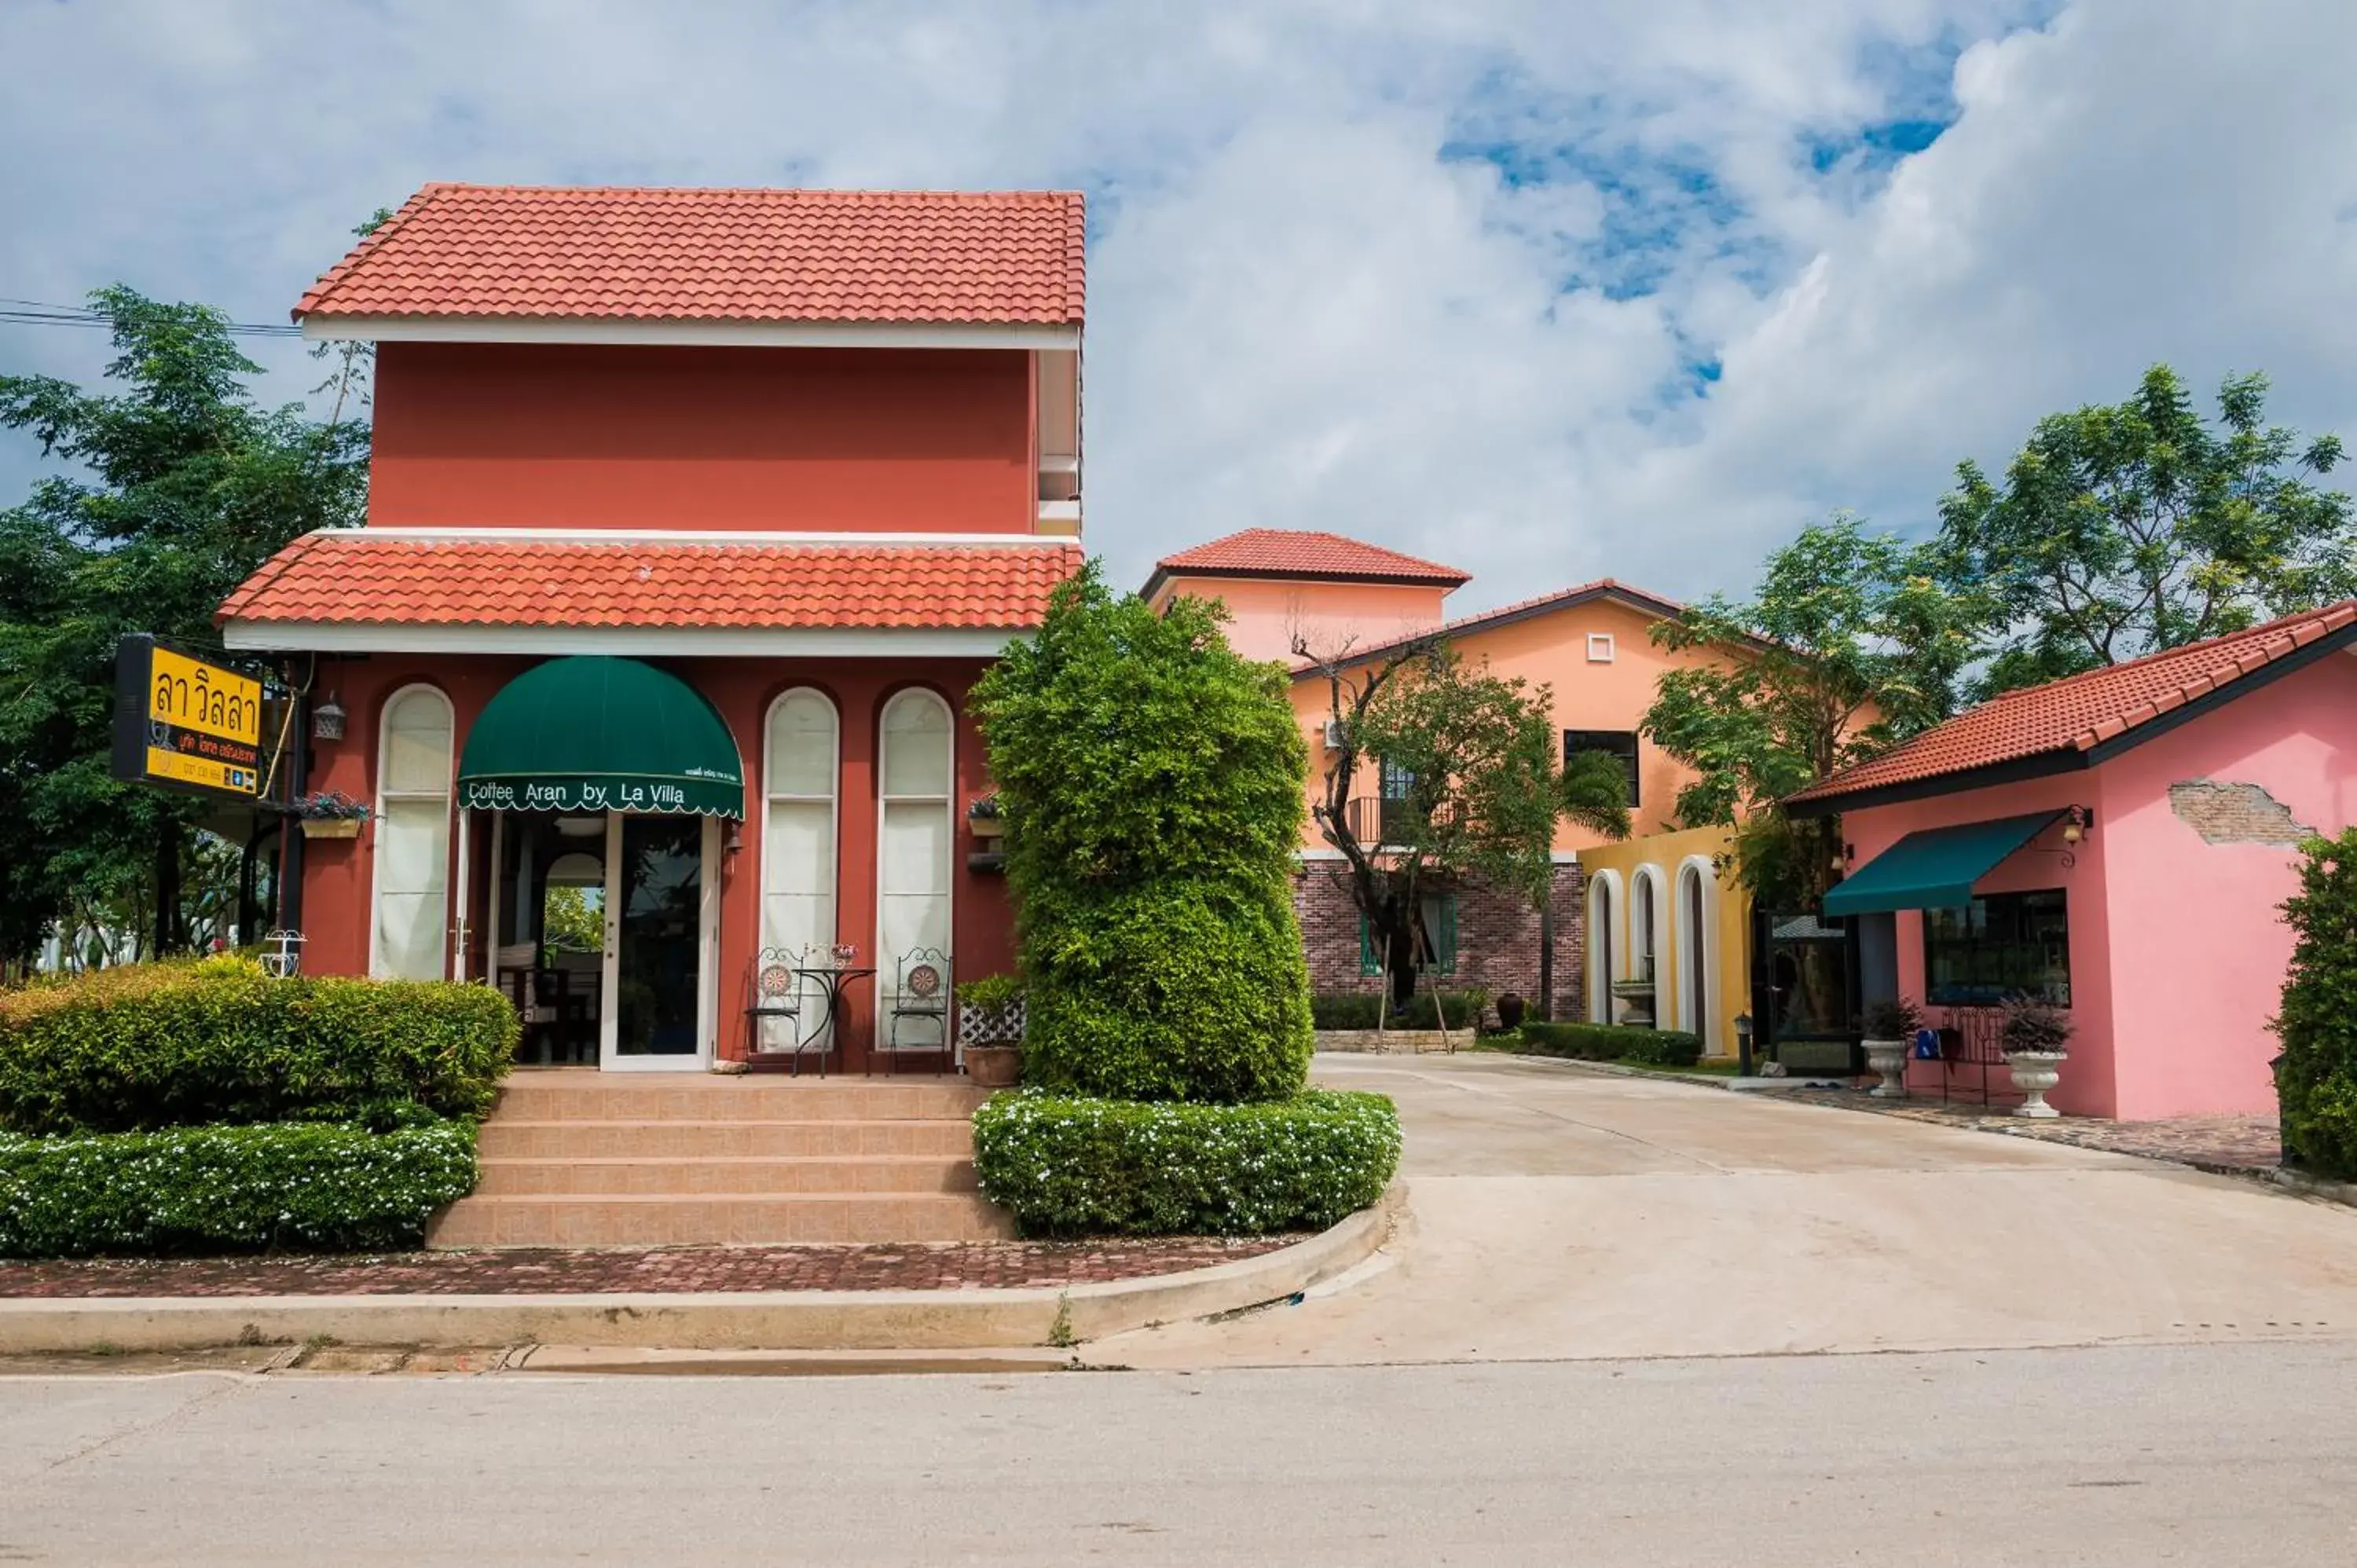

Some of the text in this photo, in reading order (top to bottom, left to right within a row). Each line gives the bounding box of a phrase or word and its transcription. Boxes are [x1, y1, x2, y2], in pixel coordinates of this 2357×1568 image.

[157, 668, 256, 735] ลาวิลล่า
[468, 782, 684, 804] Coffee Aran by La Villa
